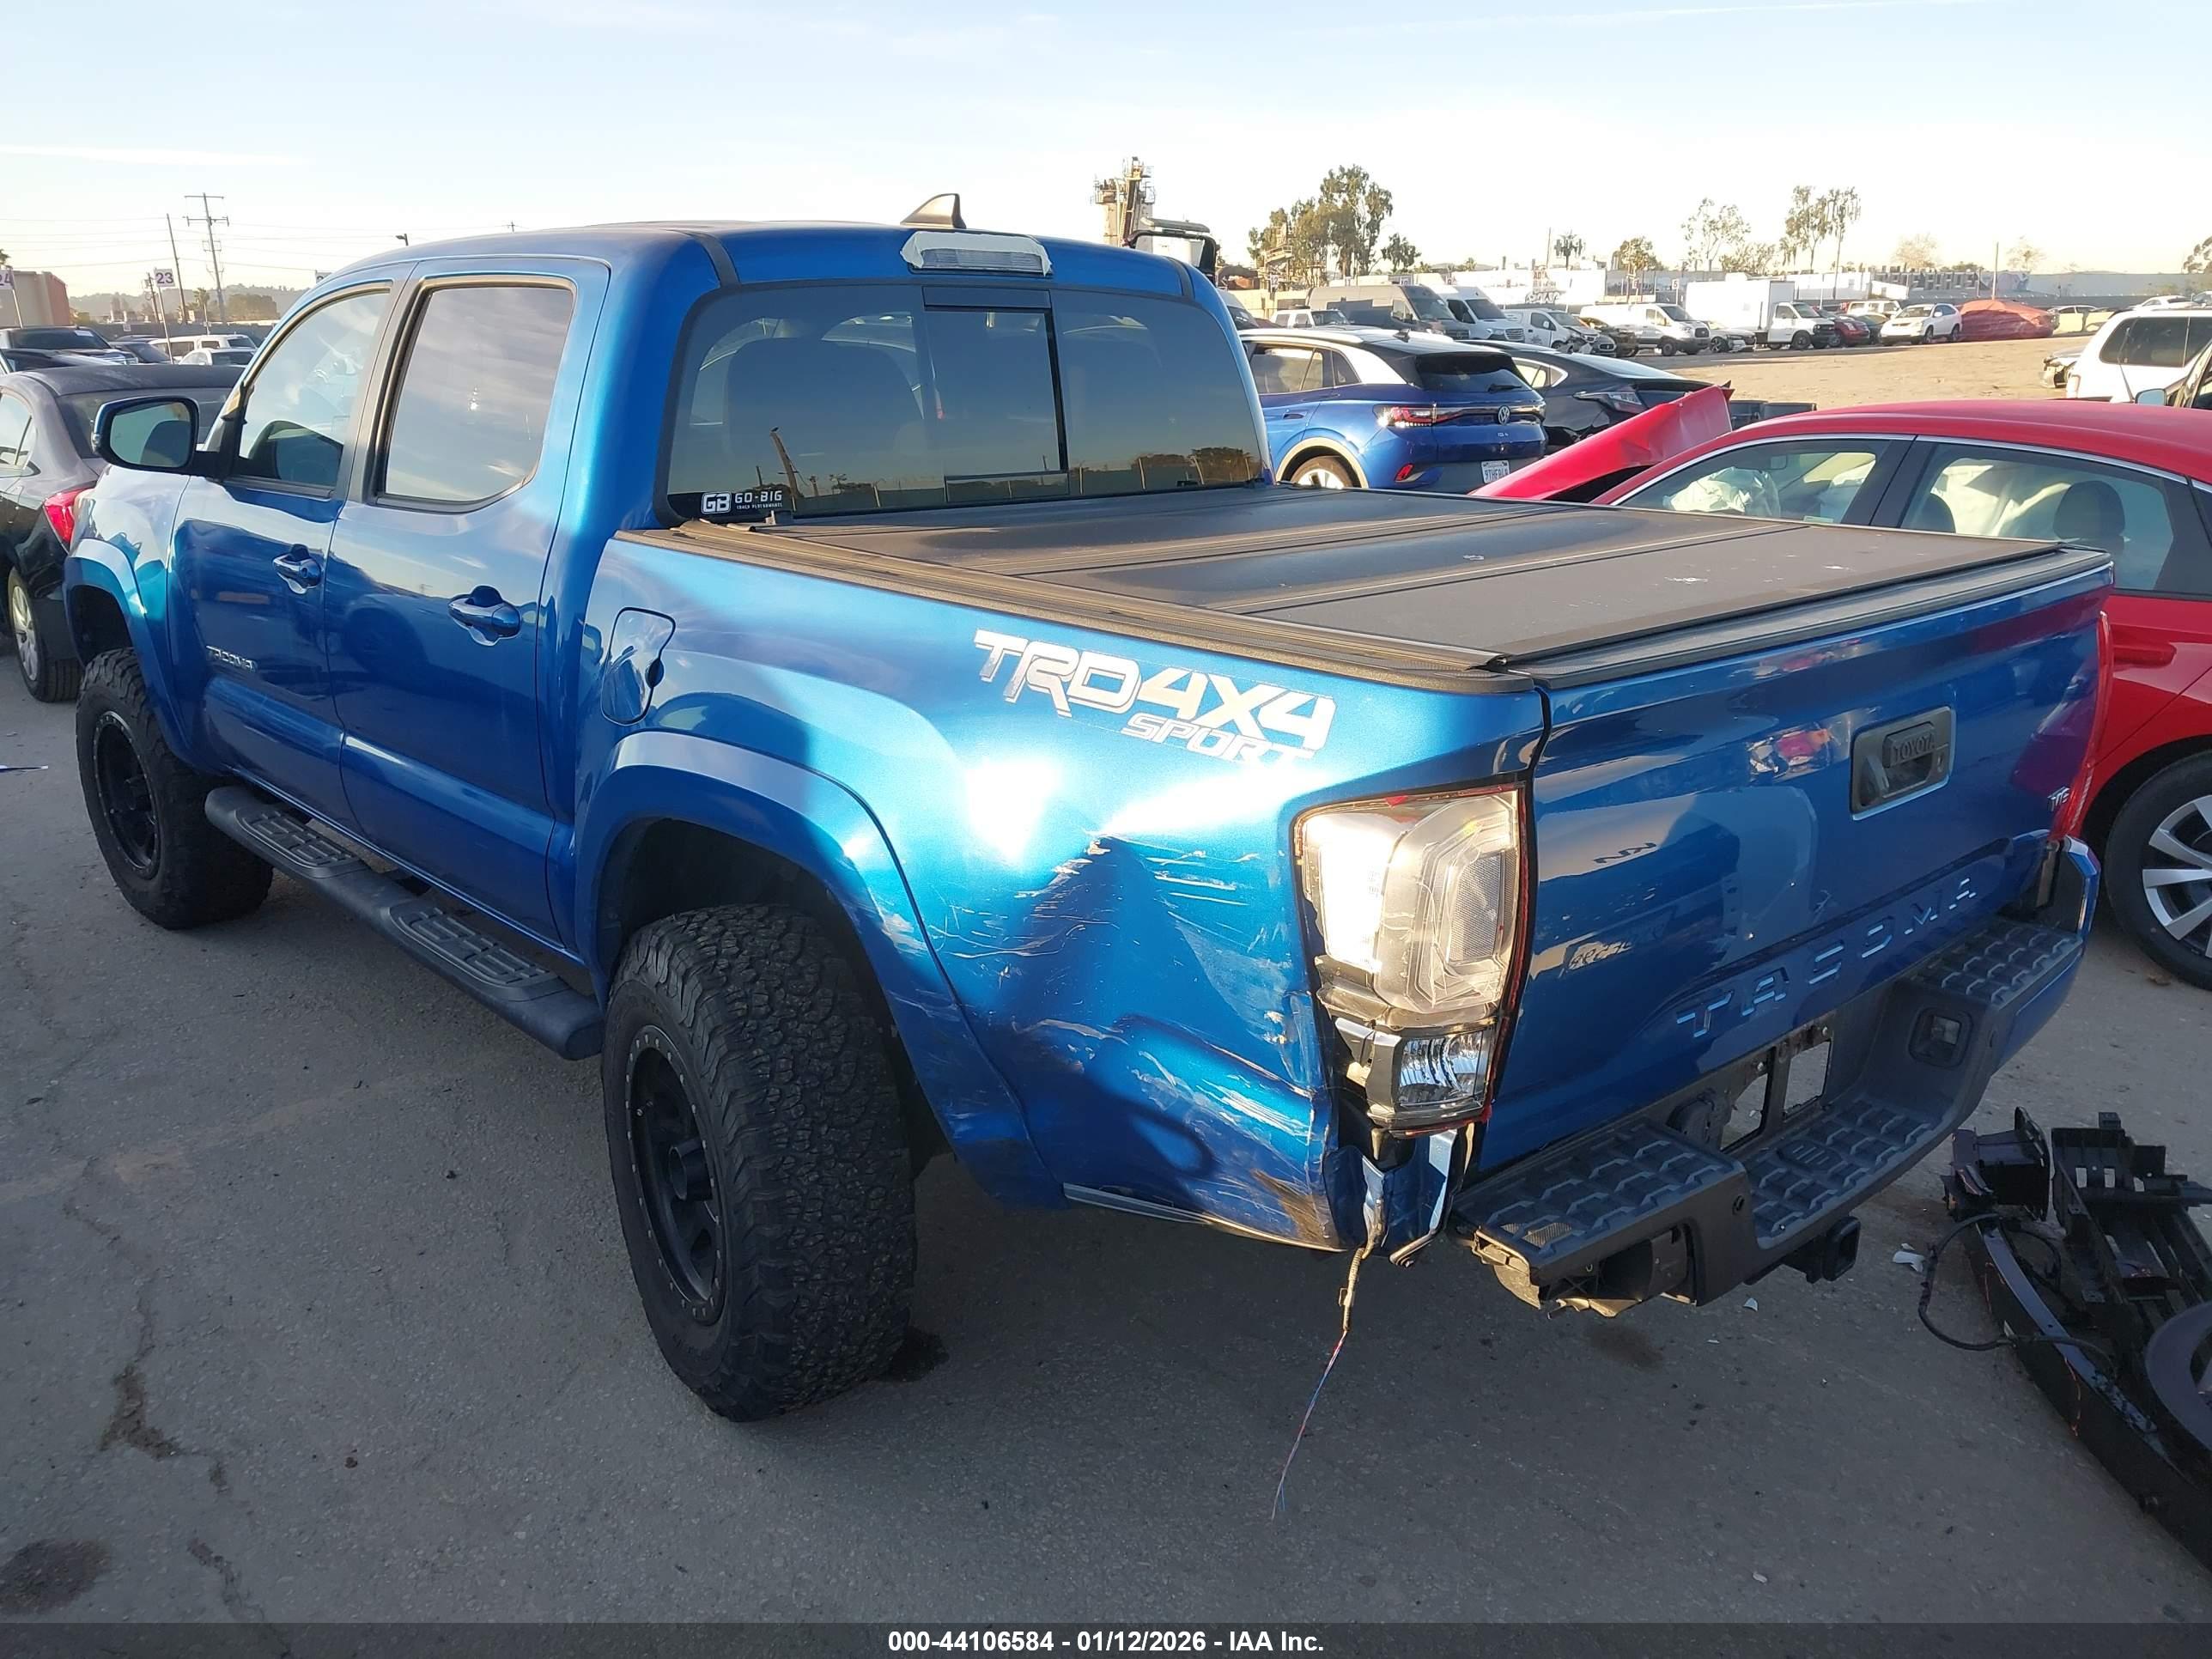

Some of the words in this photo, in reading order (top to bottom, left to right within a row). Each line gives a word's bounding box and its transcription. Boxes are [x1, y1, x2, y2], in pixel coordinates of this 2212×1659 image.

[155, 272, 174, 284] 23
[702, 493, 731, 514] GB
[1121, 712, 1316, 767] SPORT
[1893, 732, 1936, 763] TOYOTA
[1676, 877, 1977, 1038] TACOMA
